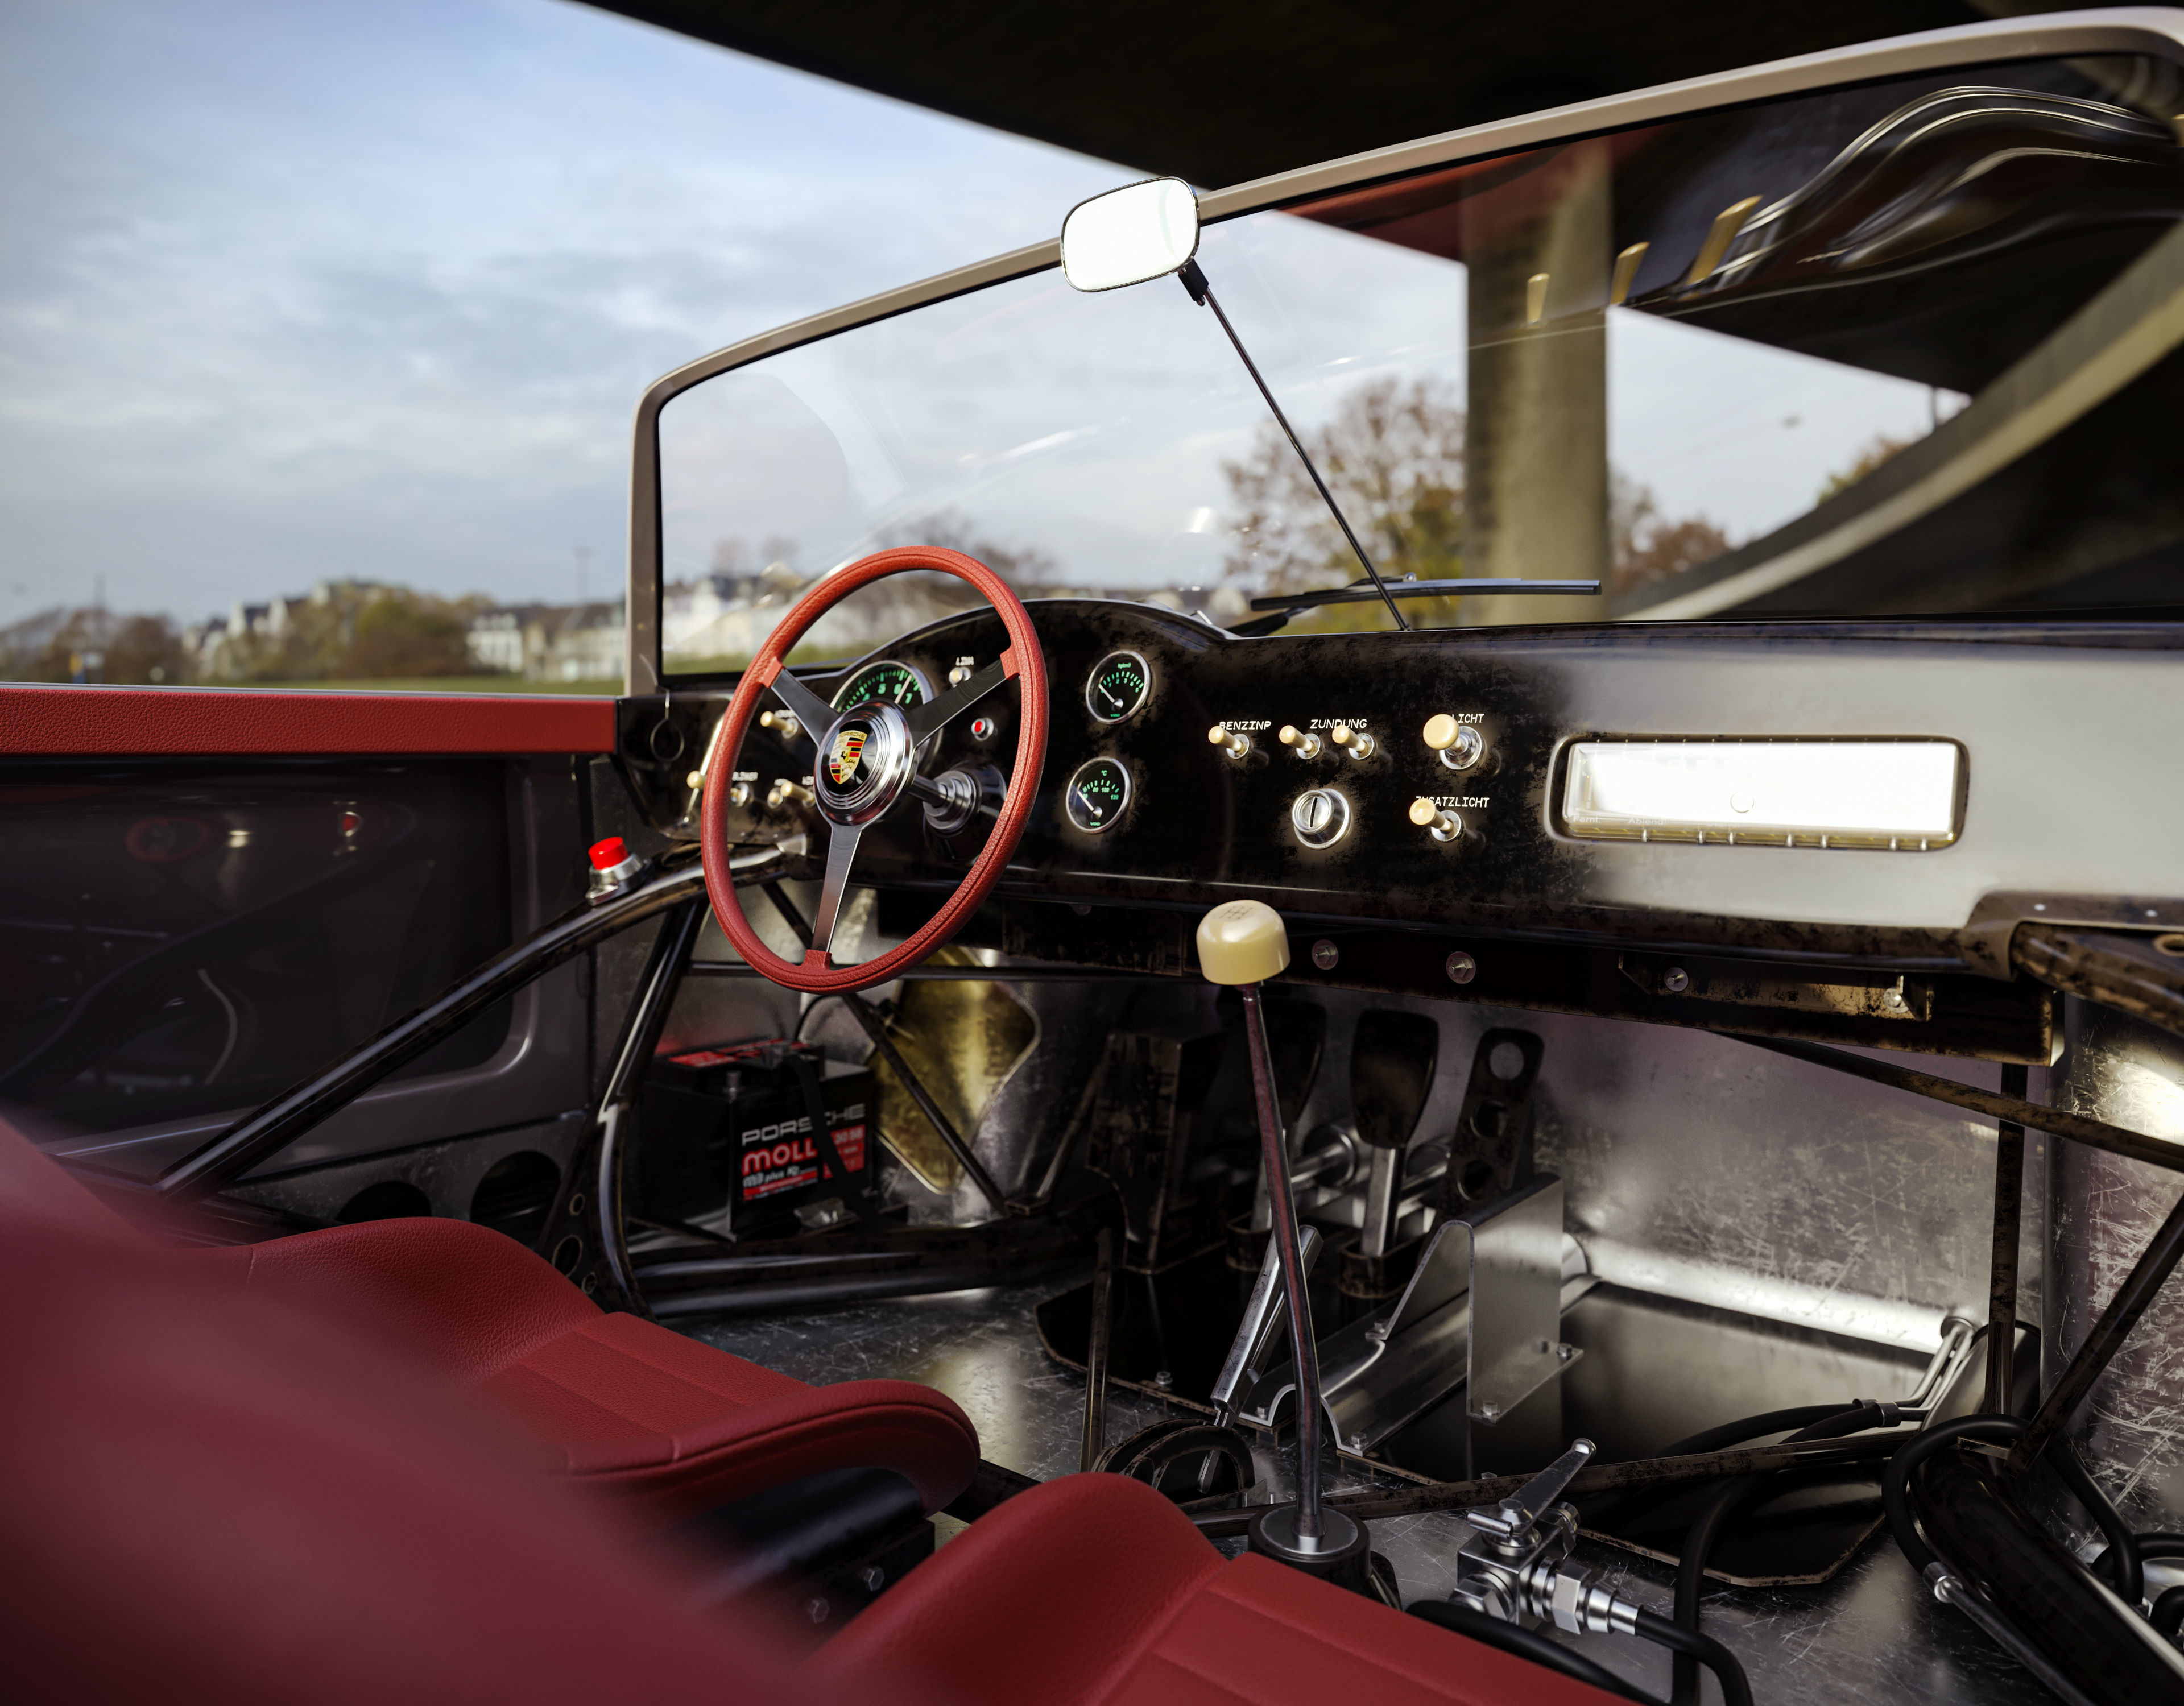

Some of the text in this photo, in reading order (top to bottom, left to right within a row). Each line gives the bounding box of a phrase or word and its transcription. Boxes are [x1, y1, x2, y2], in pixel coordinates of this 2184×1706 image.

[878, 683, 887, 695] 5
[905, 693, 913, 705] 7
[1219, 721, 1272, 730] BENZINP
[1310, 718, 1368, 729] ZUNDUNG
[1416, 796, 1490, 808] SATZLICHT
